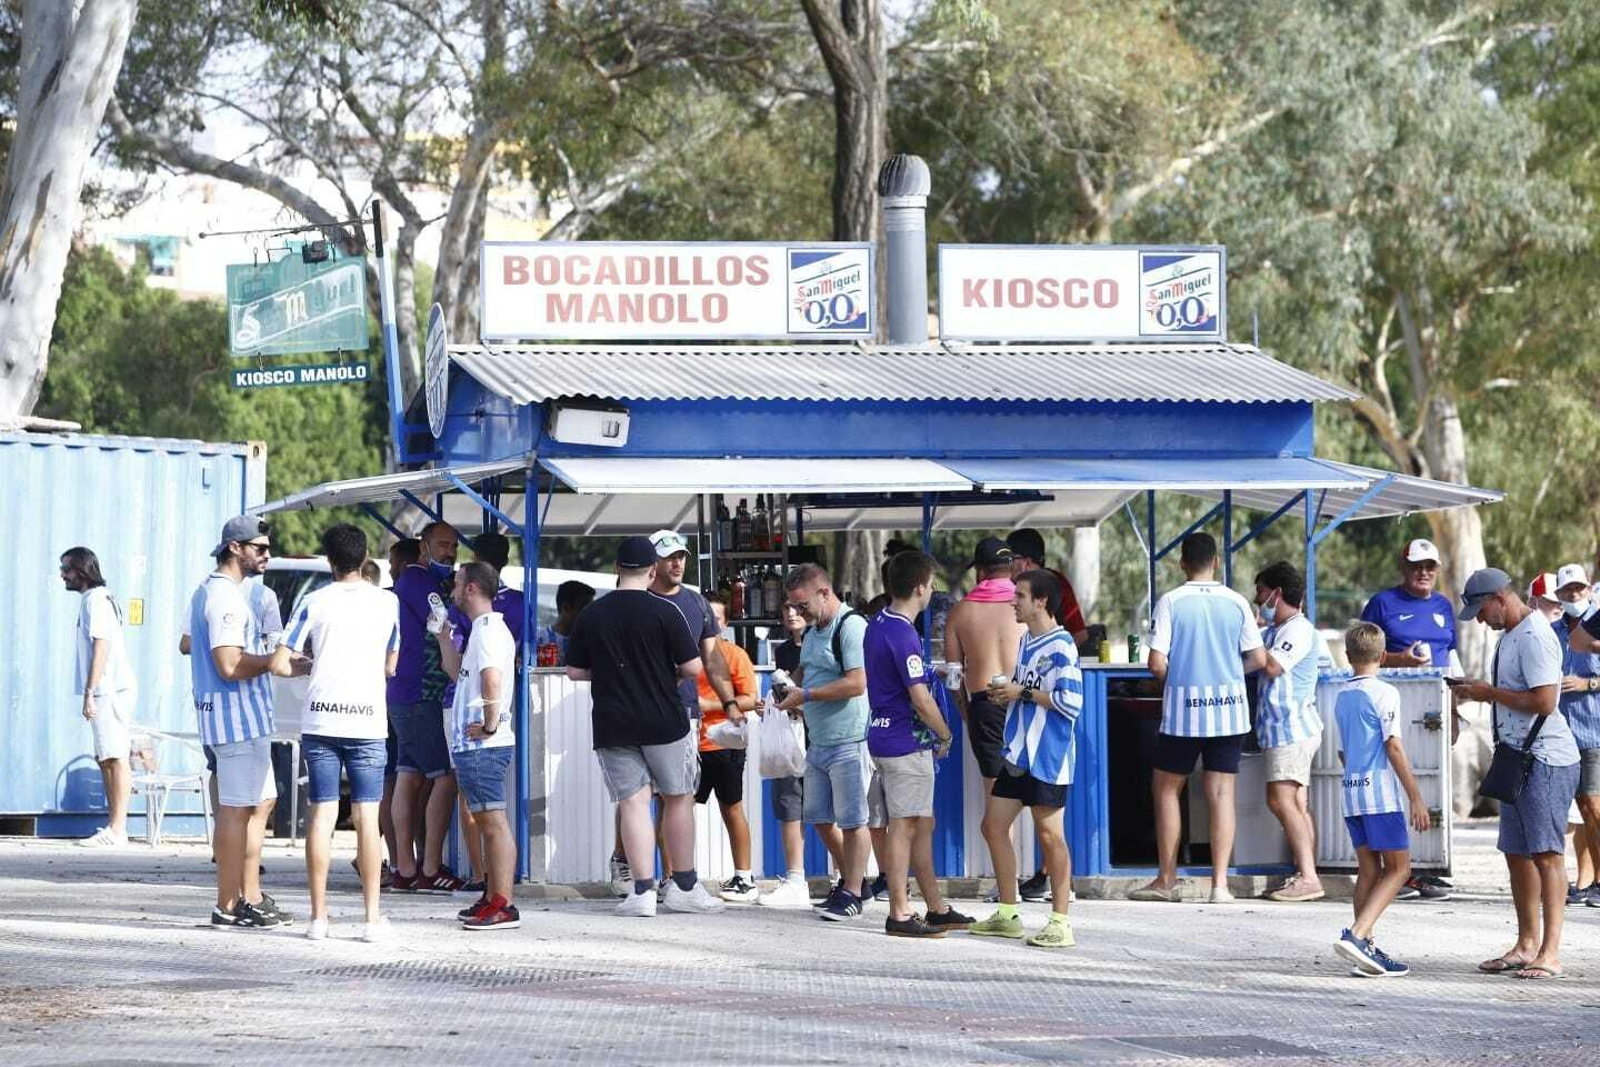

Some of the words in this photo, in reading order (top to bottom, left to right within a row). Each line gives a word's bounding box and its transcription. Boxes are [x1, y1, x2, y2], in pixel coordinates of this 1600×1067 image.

[502, 254, 770, 286] BOCADILLOS
[545, 292, 729, 323] MANOLO
[804, 293, 854, 325] 0,0
[962, 277, 1119, 309] KIOSCO
[1156, 296, 1205, 328] 0,0
[236, 370, 296, 386] KIOSCO
[300, 365, 367, 382] MANOLO
[310, 700, 374, 716] BENAHAVIS
